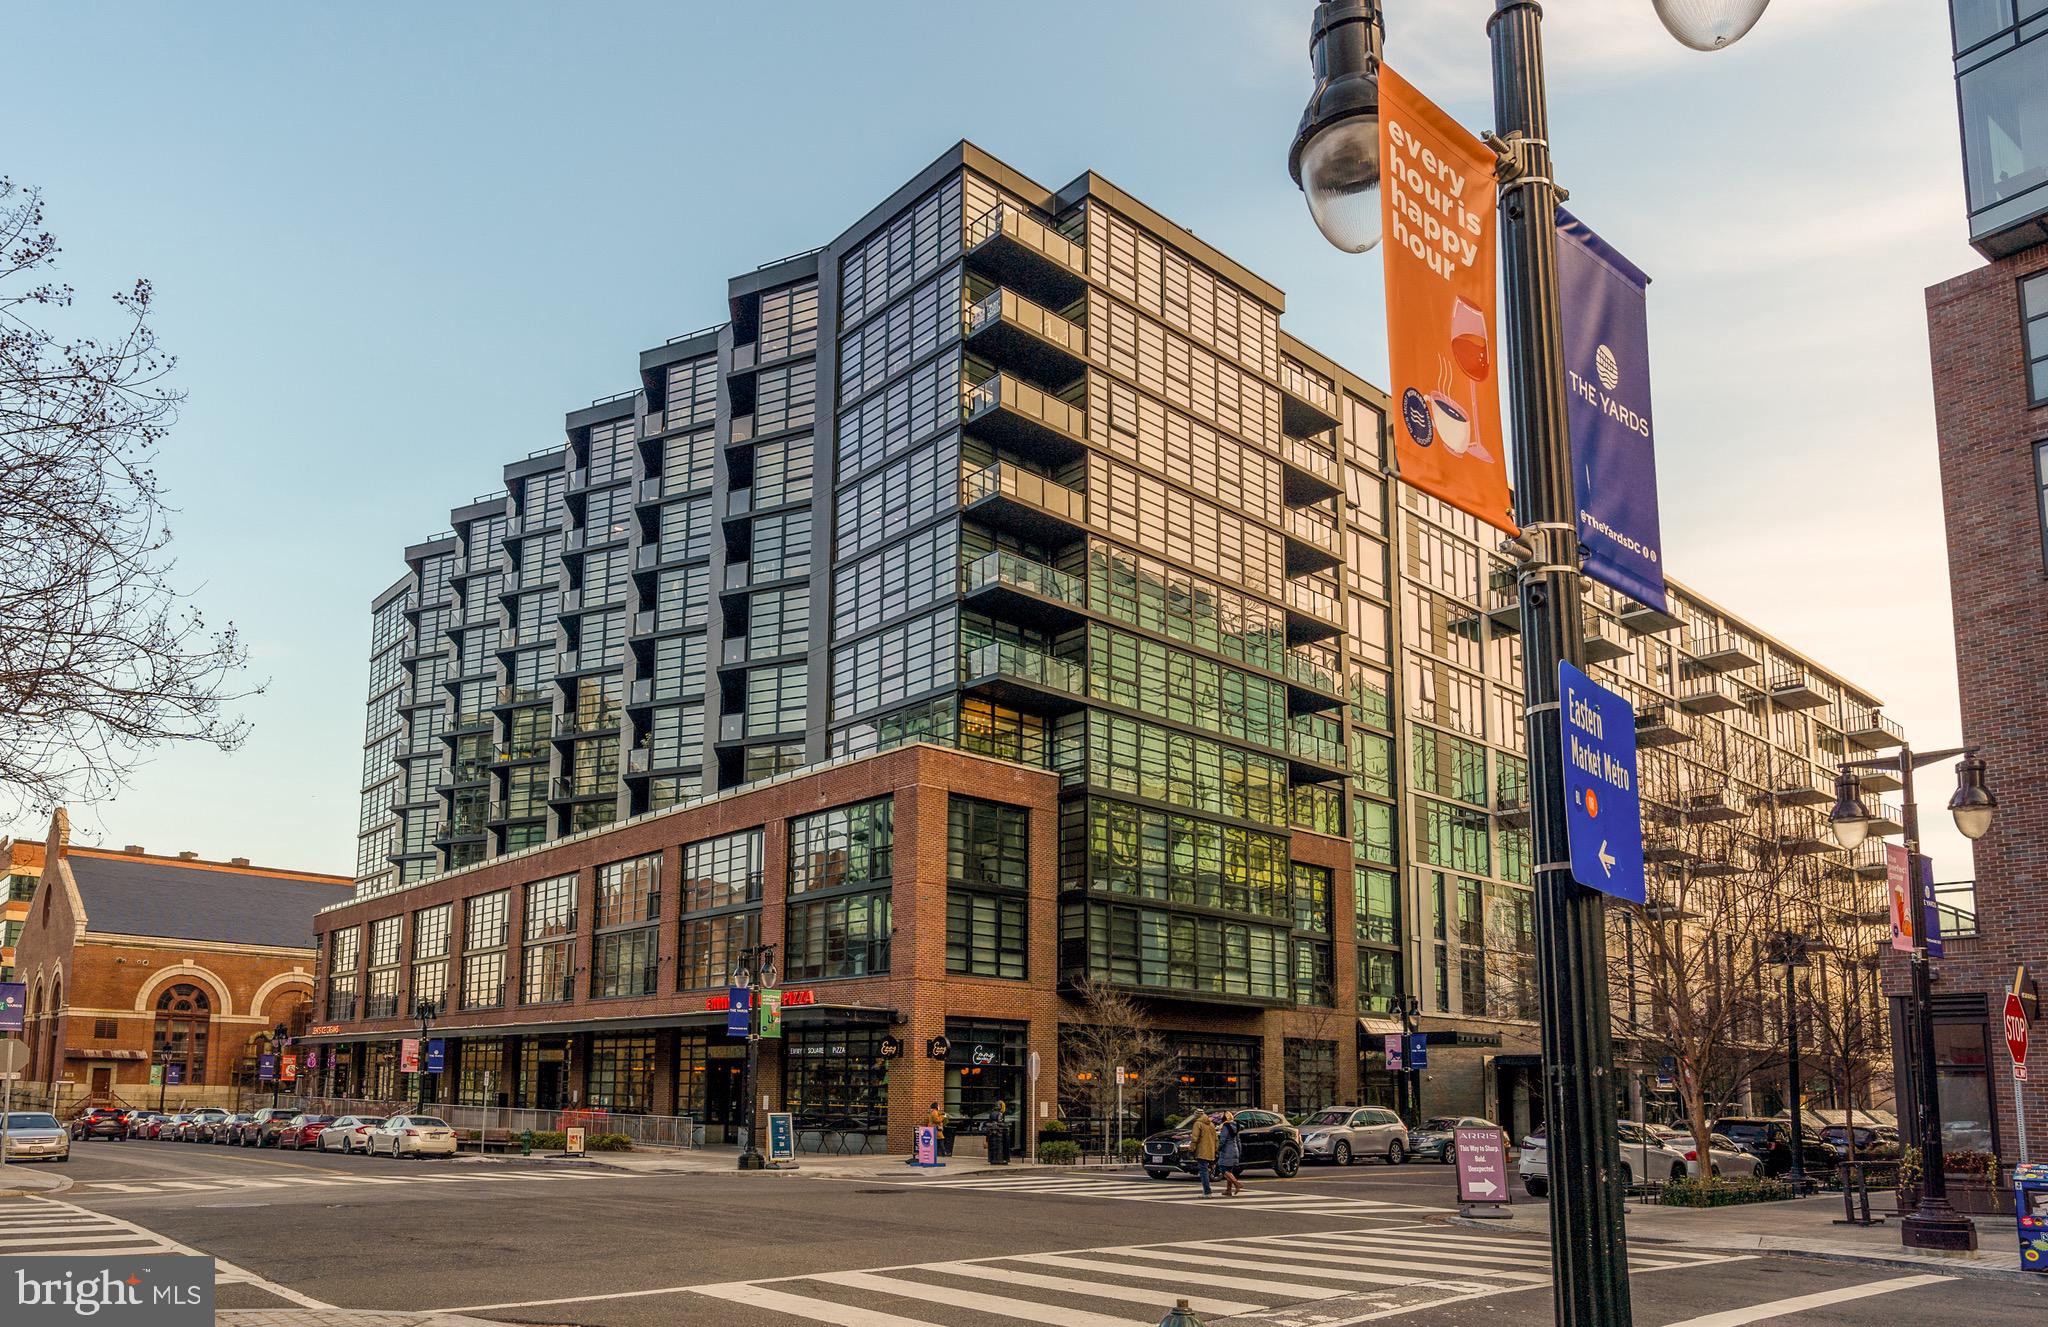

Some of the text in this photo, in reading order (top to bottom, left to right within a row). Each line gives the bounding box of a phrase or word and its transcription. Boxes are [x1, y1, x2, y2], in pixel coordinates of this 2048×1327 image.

[1388, 120, 1465, 198] every
[1390, 144, 1482, 236] hour is
[1391, 176, 1478, 267] happy
[1392, 209, 1456, 281] hour
[1569, 370, 1649, 438] THE YARDS
[1580, 509, 1641, 554] @TheYardsDC
[1568, 687, 1604, 740] Eastern
[1571, 734, 1630, 791] Market Metro
[782, 990, 815, 1005] PIZZA
[2006, 1015, 2025, 1042] STOP
[1459, 1132, 1498, 1140] ARRIS
[1469, 1145, 1479, 1153] Way
[1485, 1145, 1500, 1153] Sharp.
[1467, 1165, 1495, 1174] Unexpected.
